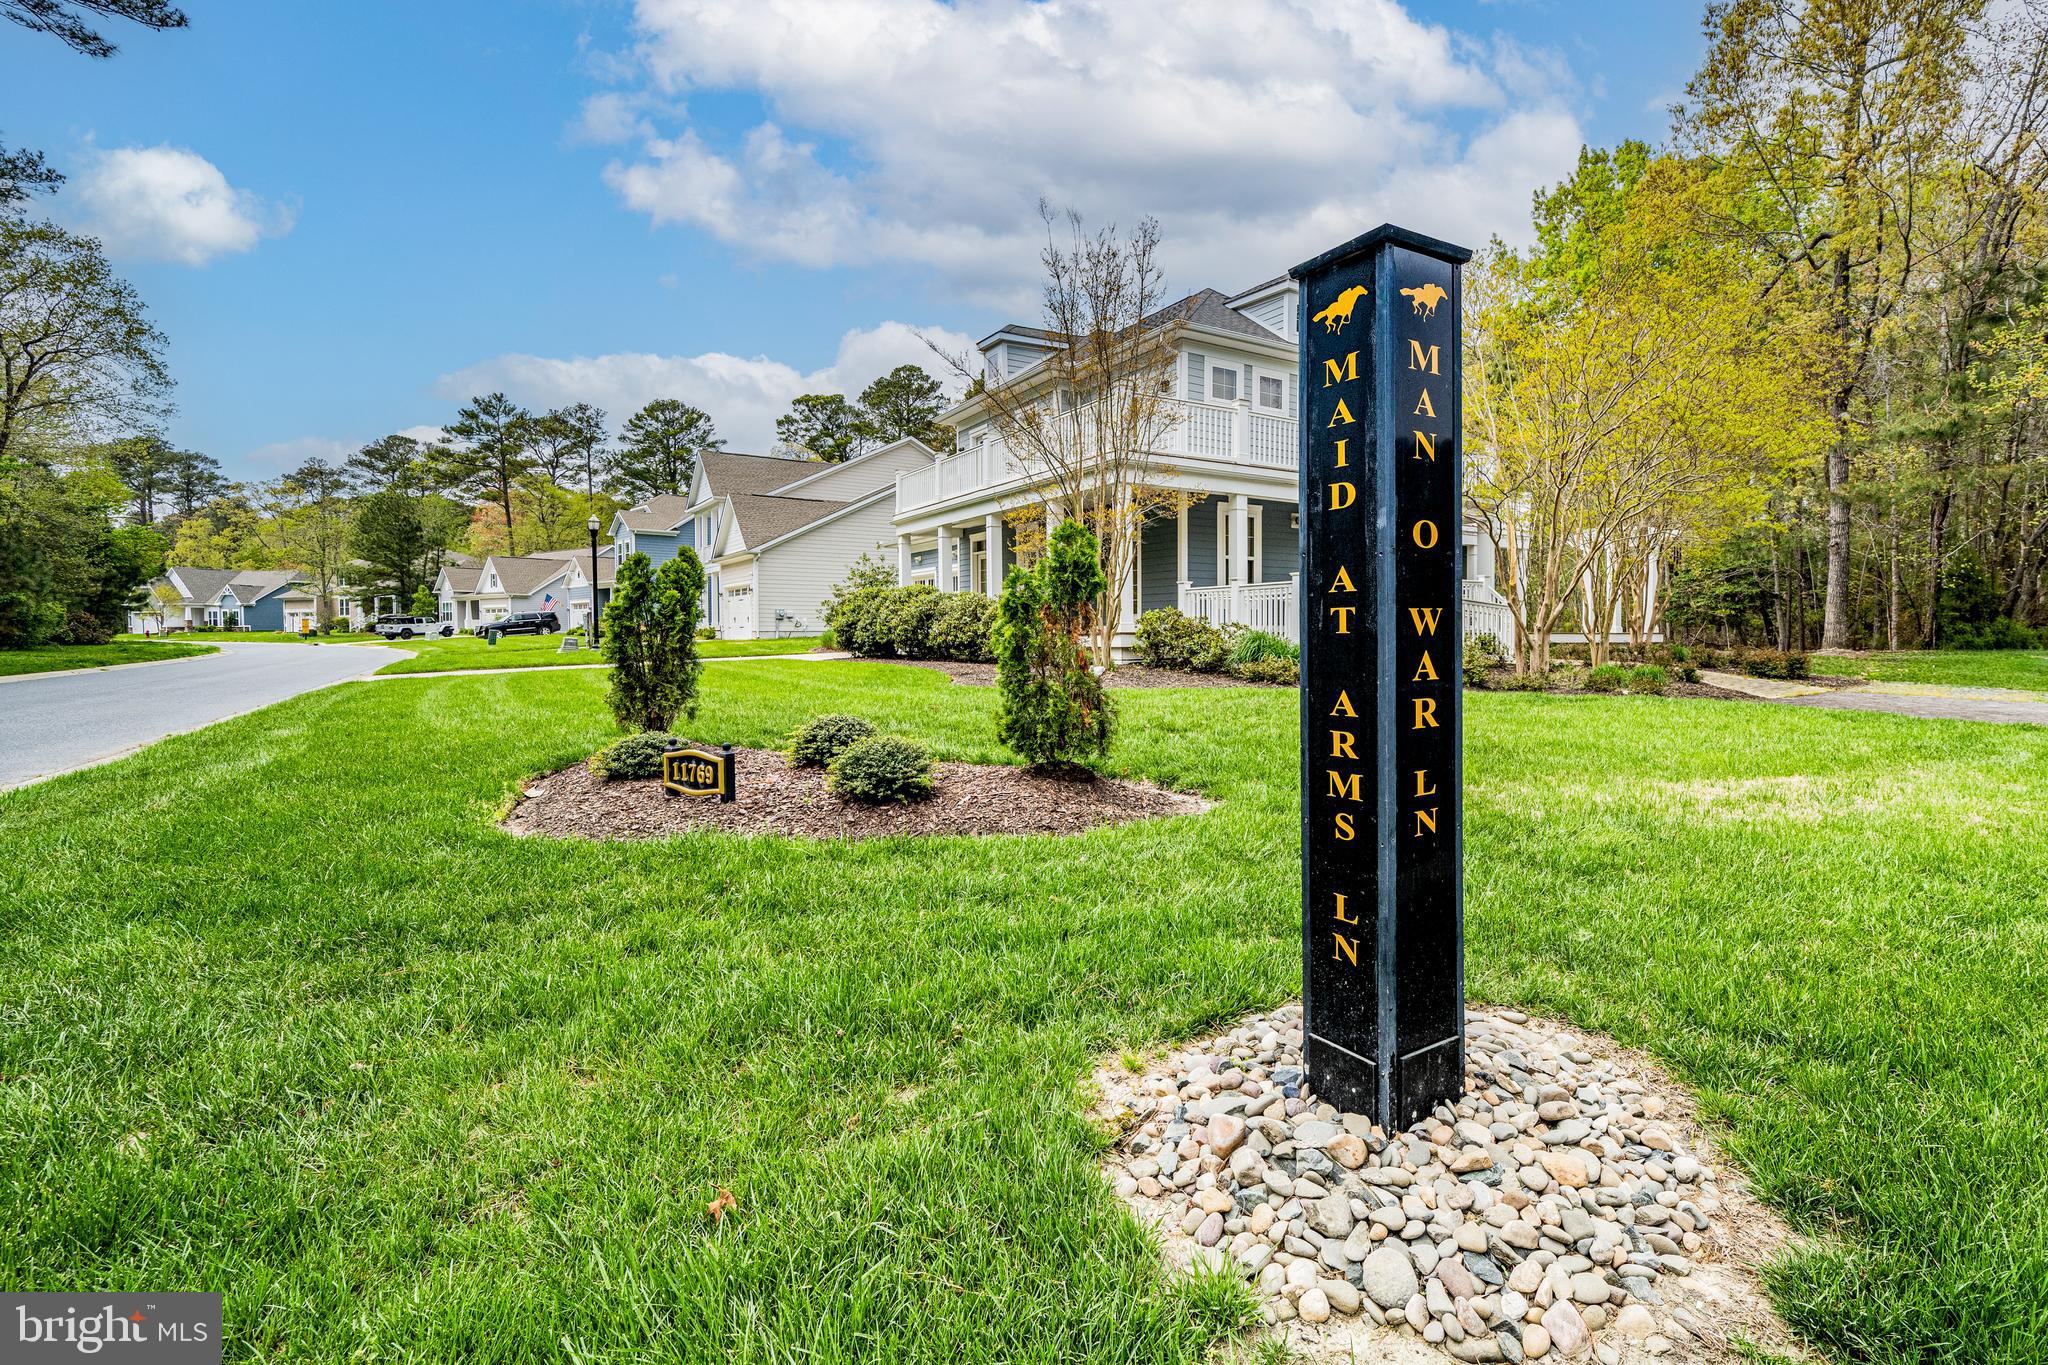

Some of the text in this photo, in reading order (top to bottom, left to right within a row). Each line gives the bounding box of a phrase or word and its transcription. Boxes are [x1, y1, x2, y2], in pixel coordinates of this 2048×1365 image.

[672, 761, 714, 785] 11769
[1322, 350, 1364, 967] MAID AT ARMS LN
[1407, 339, 1443, 837] MAN O WAR LN
